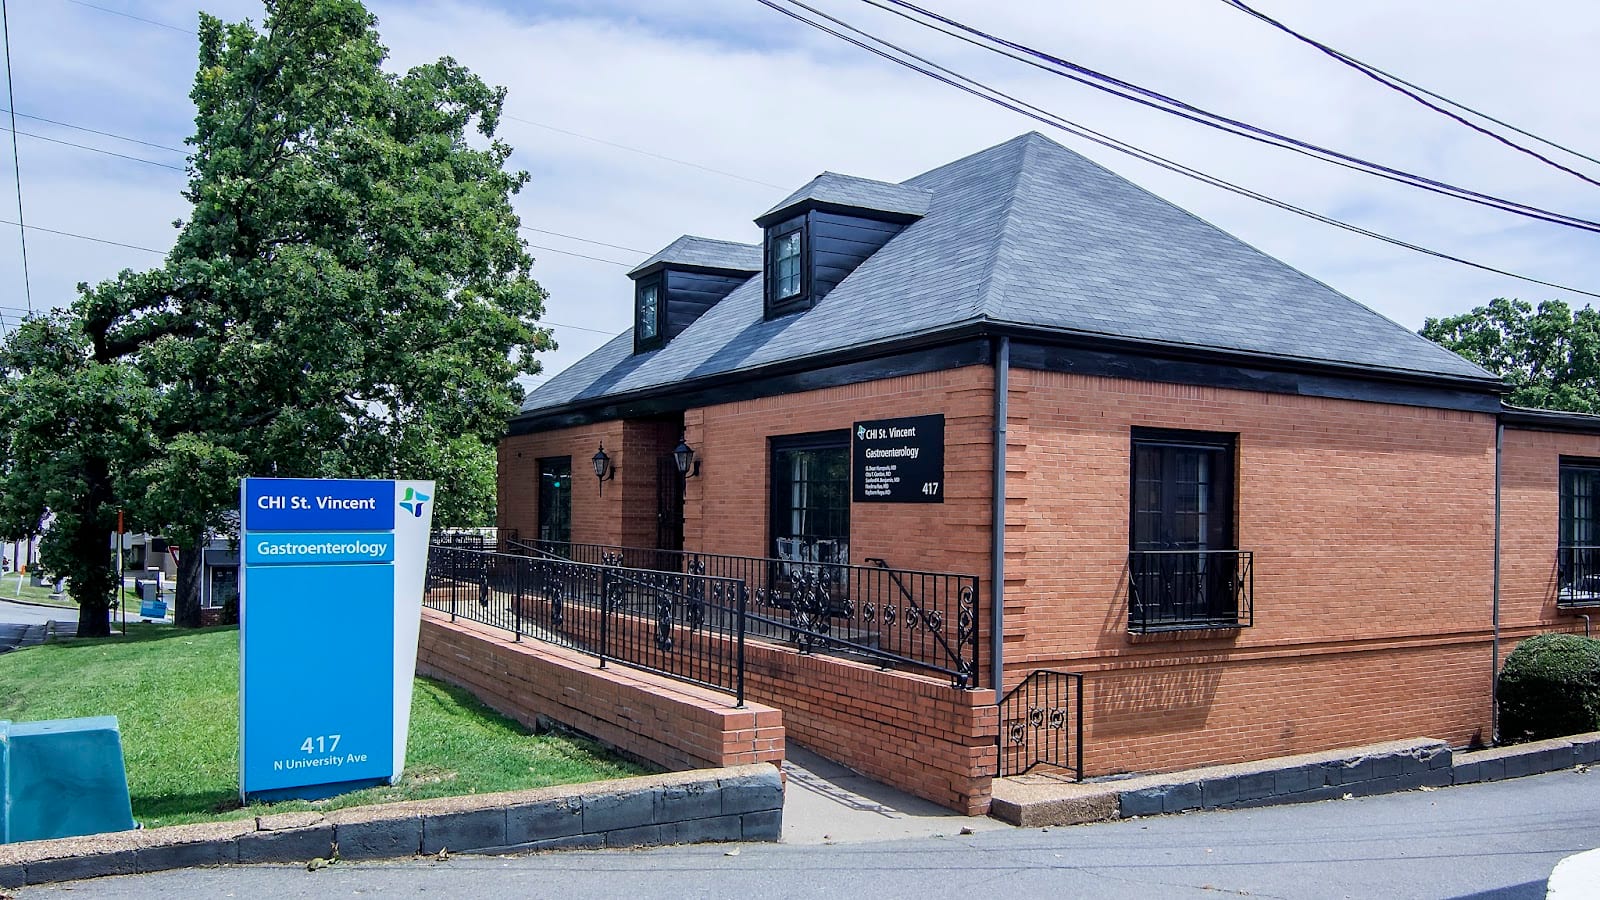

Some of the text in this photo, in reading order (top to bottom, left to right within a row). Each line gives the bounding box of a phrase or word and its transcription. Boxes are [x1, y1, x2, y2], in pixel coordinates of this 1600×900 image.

[865, 426, 916, 440] CHI St. Vincent
[865, 445, 920, 459] Gastroenterology
[922, 482, 939, 495] 417
[257, 495, 376, 510] CHI St. Vincent
[257, 540, 388, 557] Gastroenterology
[300, 734, 342, 754] 417
[274, 753, 368, 771] N University Ave
